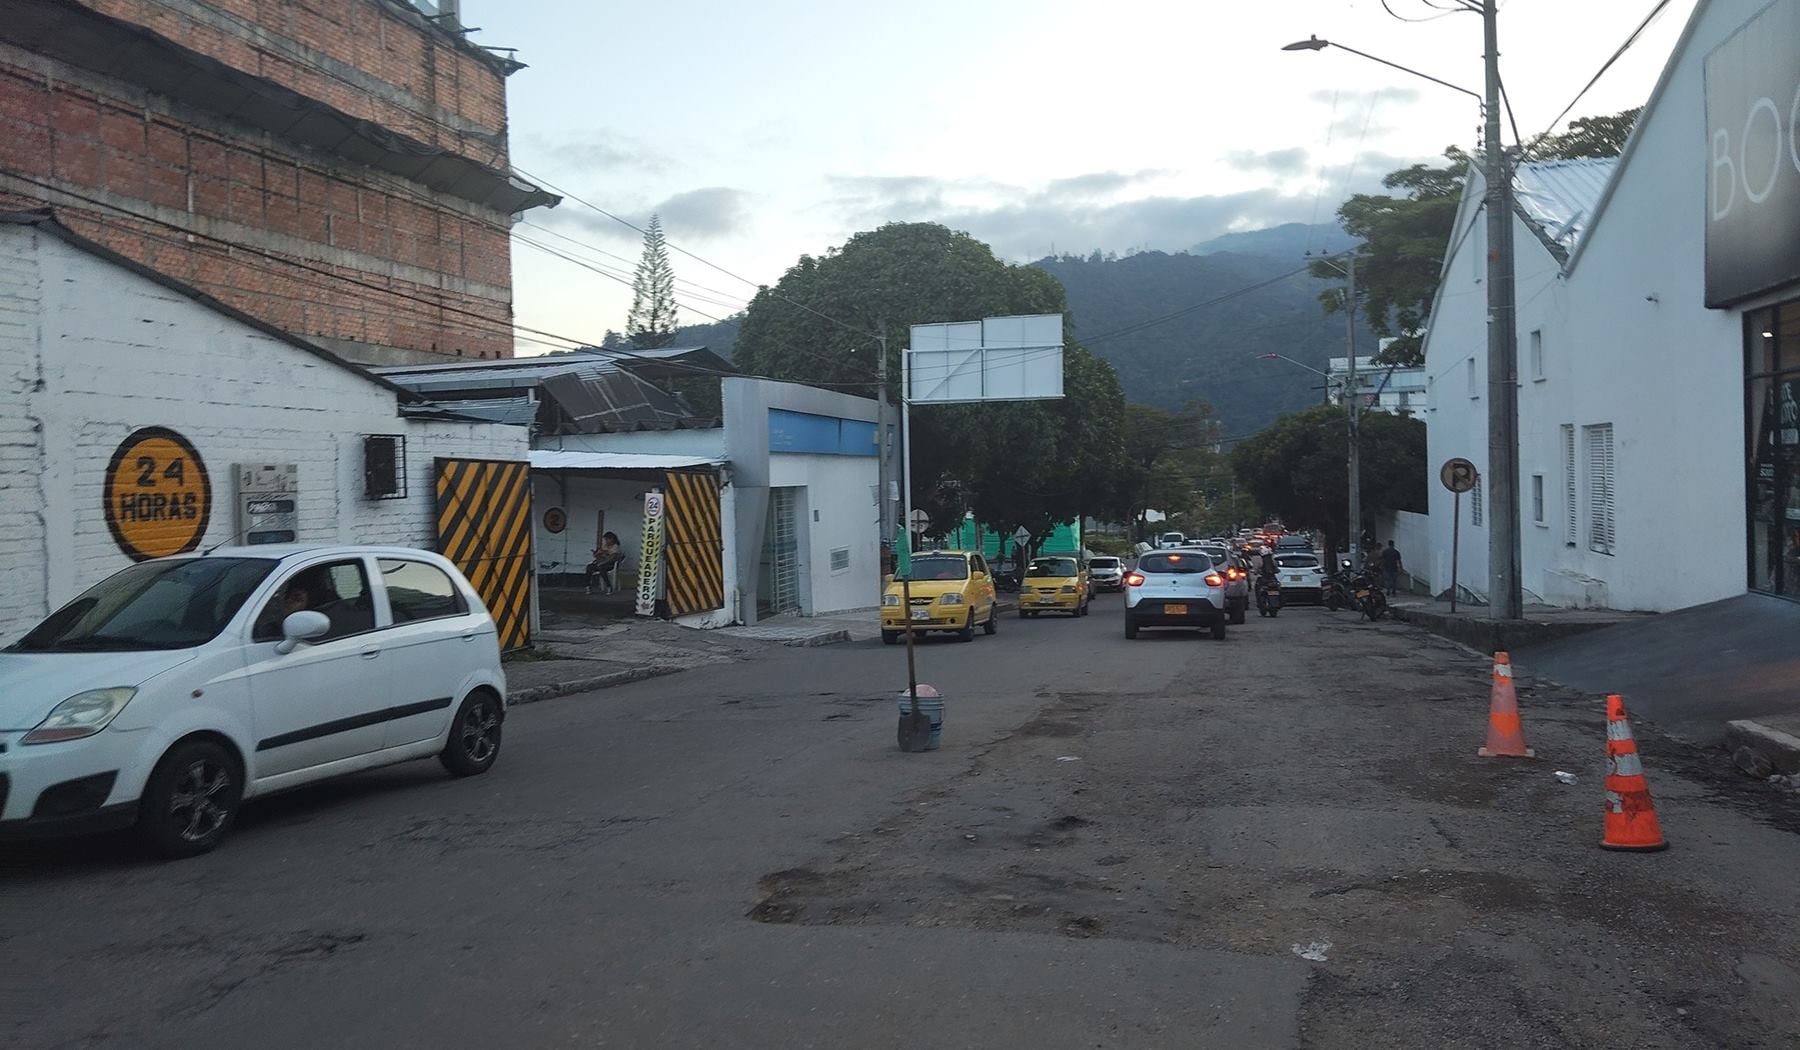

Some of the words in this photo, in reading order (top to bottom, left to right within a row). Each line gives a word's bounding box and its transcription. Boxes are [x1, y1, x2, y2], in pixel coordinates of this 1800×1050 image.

[136, 456, 184, 487] 24
[120, 492, 197, 522] HORAS
[642, 518, 656, 601] PARQUEADERO
